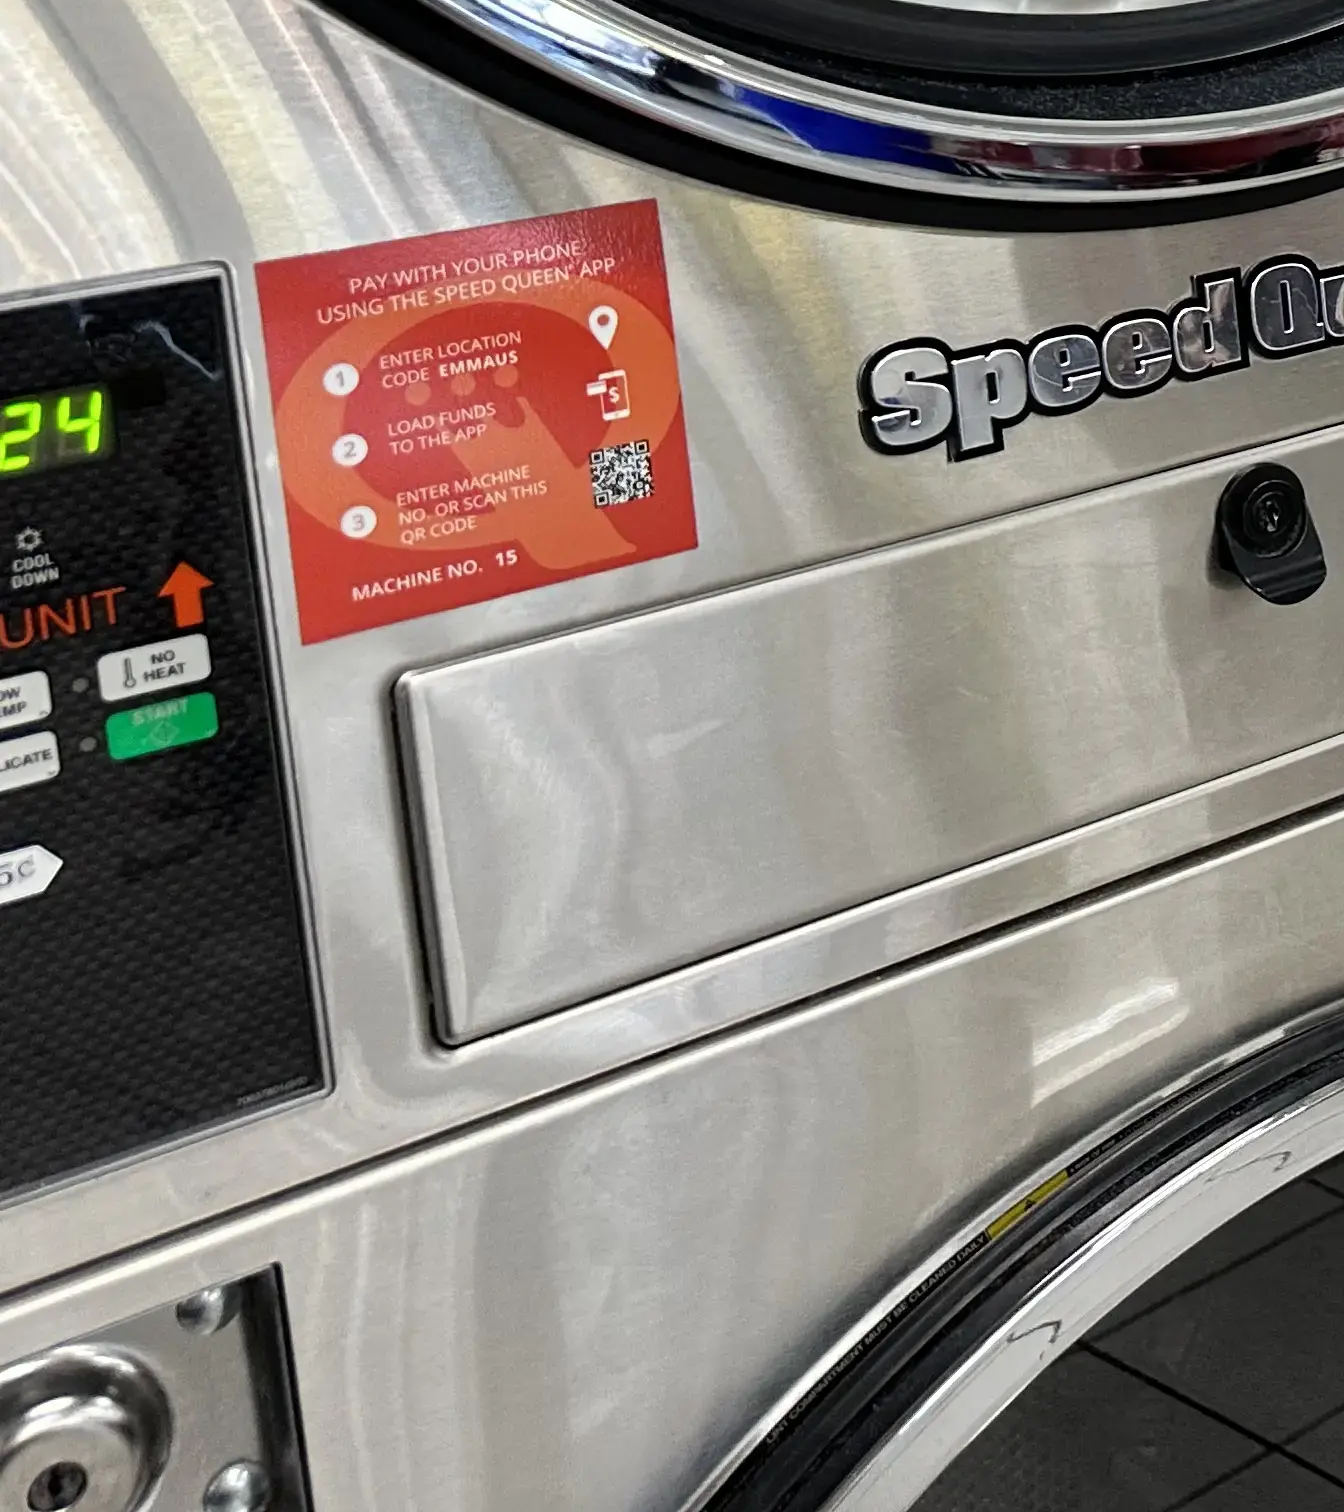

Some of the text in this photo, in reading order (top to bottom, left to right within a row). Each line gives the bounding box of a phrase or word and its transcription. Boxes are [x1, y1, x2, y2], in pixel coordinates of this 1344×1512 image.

[350, 242, 582, 294] PAY WITH YOUR PHONE
[316, 299, 384, 325] USING
[388, 290, 429, 311] THE
[434, 278, 496, 304] SPEED
[580, 257, 616, 277] APP
[379, 331, 522, 370] ENTER LOCATION
[382, 350, 518, 389] CODE EMMAUS
[858, 267, 1250, 462] Speed
[0, 391, 102, 472] 24
[387, 402, 497, 437] LOAD FUNDS
[390, 424, 487, 455] TO THE APP
[396, 465, 531, 507] ENTER MACHINE
[398, 480, 548, 526] NO. OR SCAN THIS
[400, 515, 477, 545] QR CODE
[10, 567, 60, 590] DOWN
[12, 553, 54, 573] COOL
[352, 549, 518, 601] MACHINE NO. 15
[0, 586, 126, 649] UNIT
[143, 662, 186, 682] HEAT
[151, 650, 176, 665] NO
[130, 698, 190, 727] START
